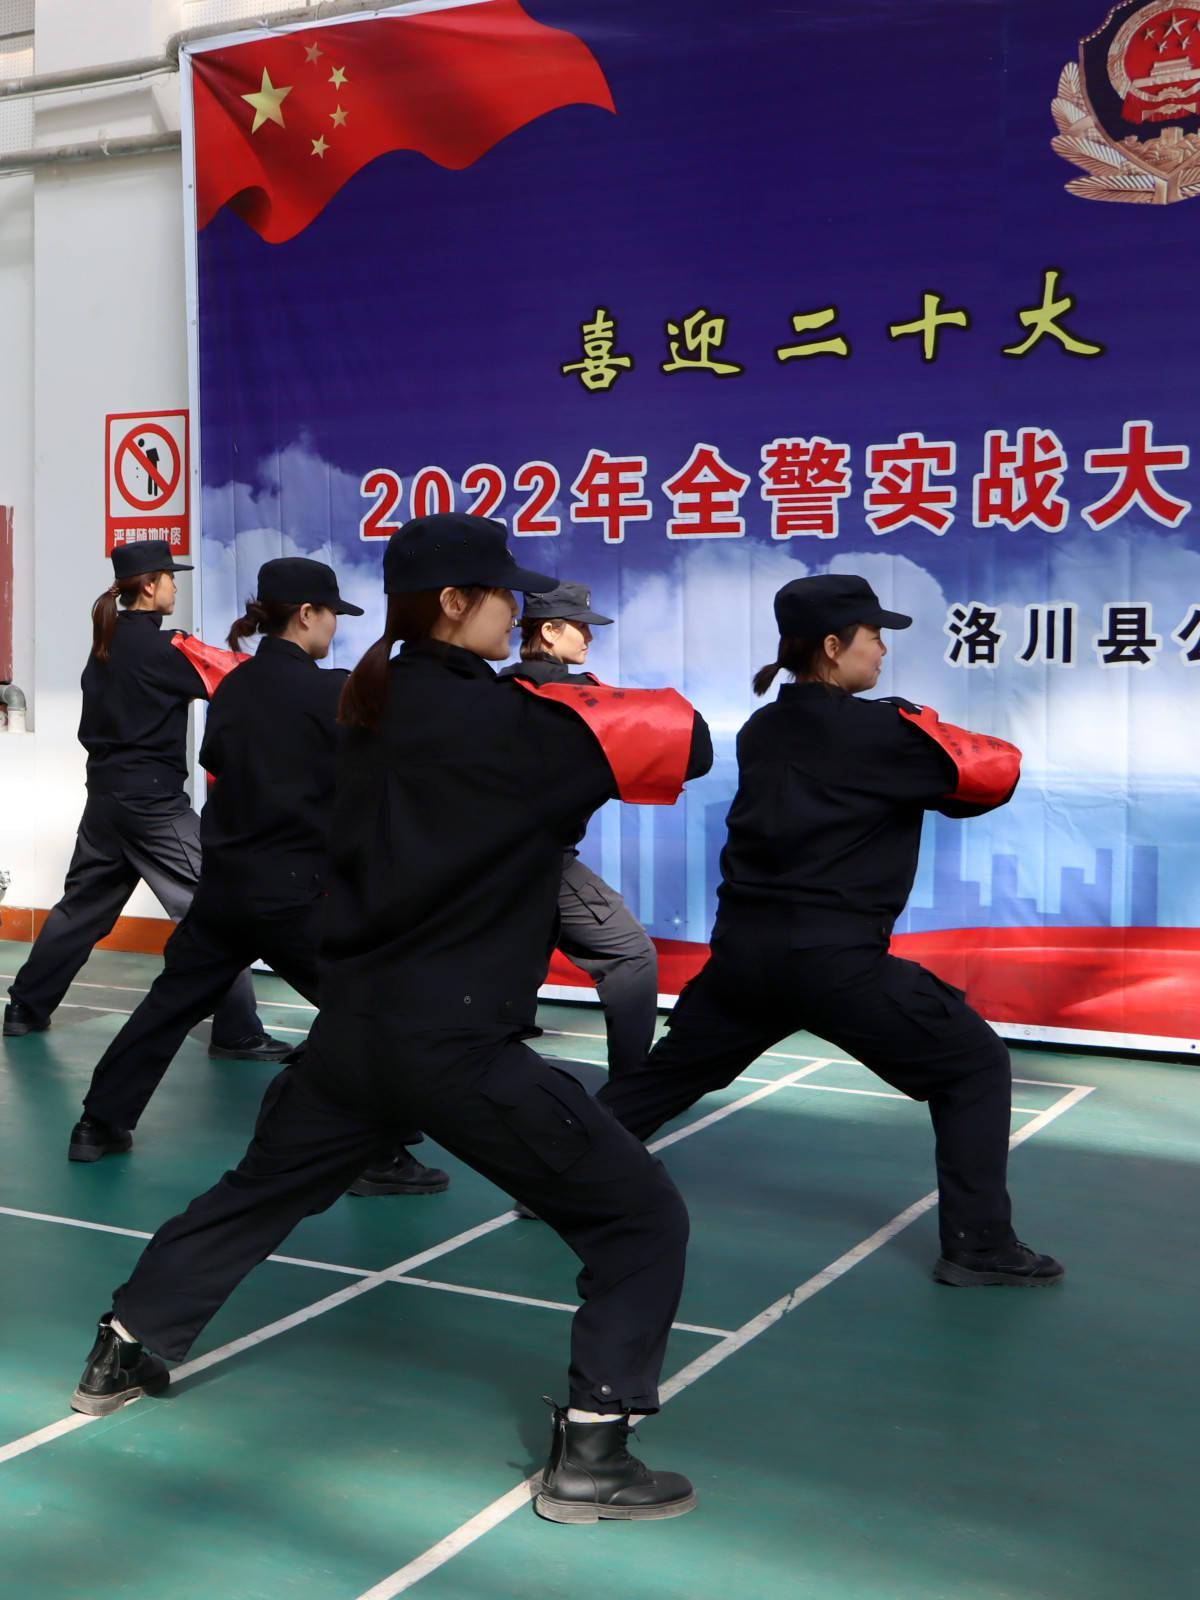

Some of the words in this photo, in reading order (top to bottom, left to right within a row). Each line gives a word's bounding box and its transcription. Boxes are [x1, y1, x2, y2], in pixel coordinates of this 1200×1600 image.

[562, 270, 1102, 391] 喜迎二十大
[360, 422, 1190, 542] 2022年全警实战大
